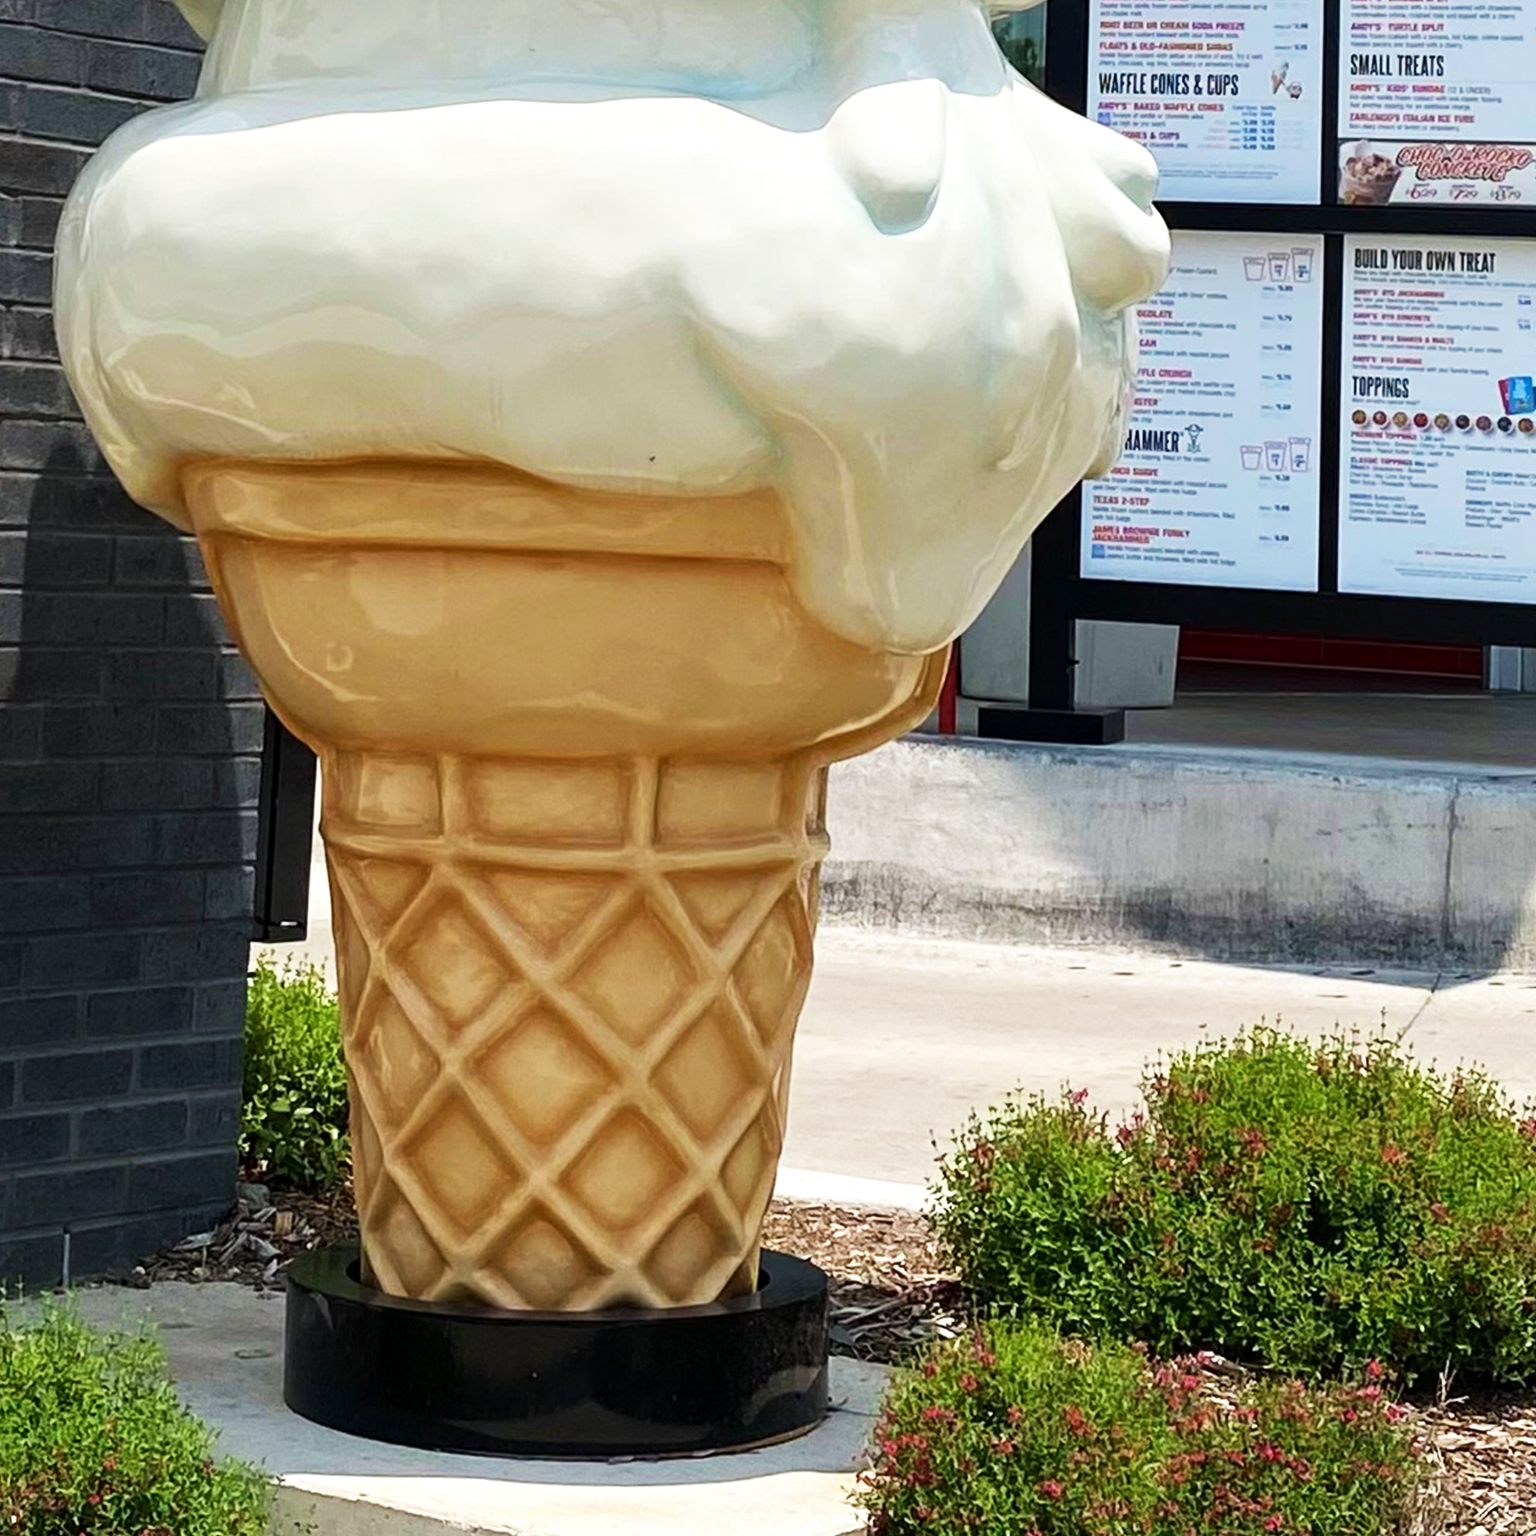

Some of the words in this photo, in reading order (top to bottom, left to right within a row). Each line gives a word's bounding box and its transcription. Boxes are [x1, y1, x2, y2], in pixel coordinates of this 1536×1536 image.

[1123, 21, 1143, 30] BEER
[1350, 54, 1392, 76] SMALL
[1397, 55, 1444, 76] TREATS
[1099, 73, 1146, 95] WAFFLE
[1150, 73, 1189, 95] CONES
[1193, 73, 1202, 95] &
[1207, 73, 1238, 95] CUPS
[1412, 84, 1445, 93] SUNDAE
[1134, 102, 1160, 110] BAKED
[1417, 163, 1506, 181] CONCRETE
[1354, 249, 1388, 269] BUILD
[1392, 250, 1423, 270] YOUR
[1426, 251, 1455, 271] OWN
[1459, 252, 1496, 272] TREAT
[1352, 376, 1409, 398] TOPPINGS
[1124, 429, 1180, 452] HAMMER
